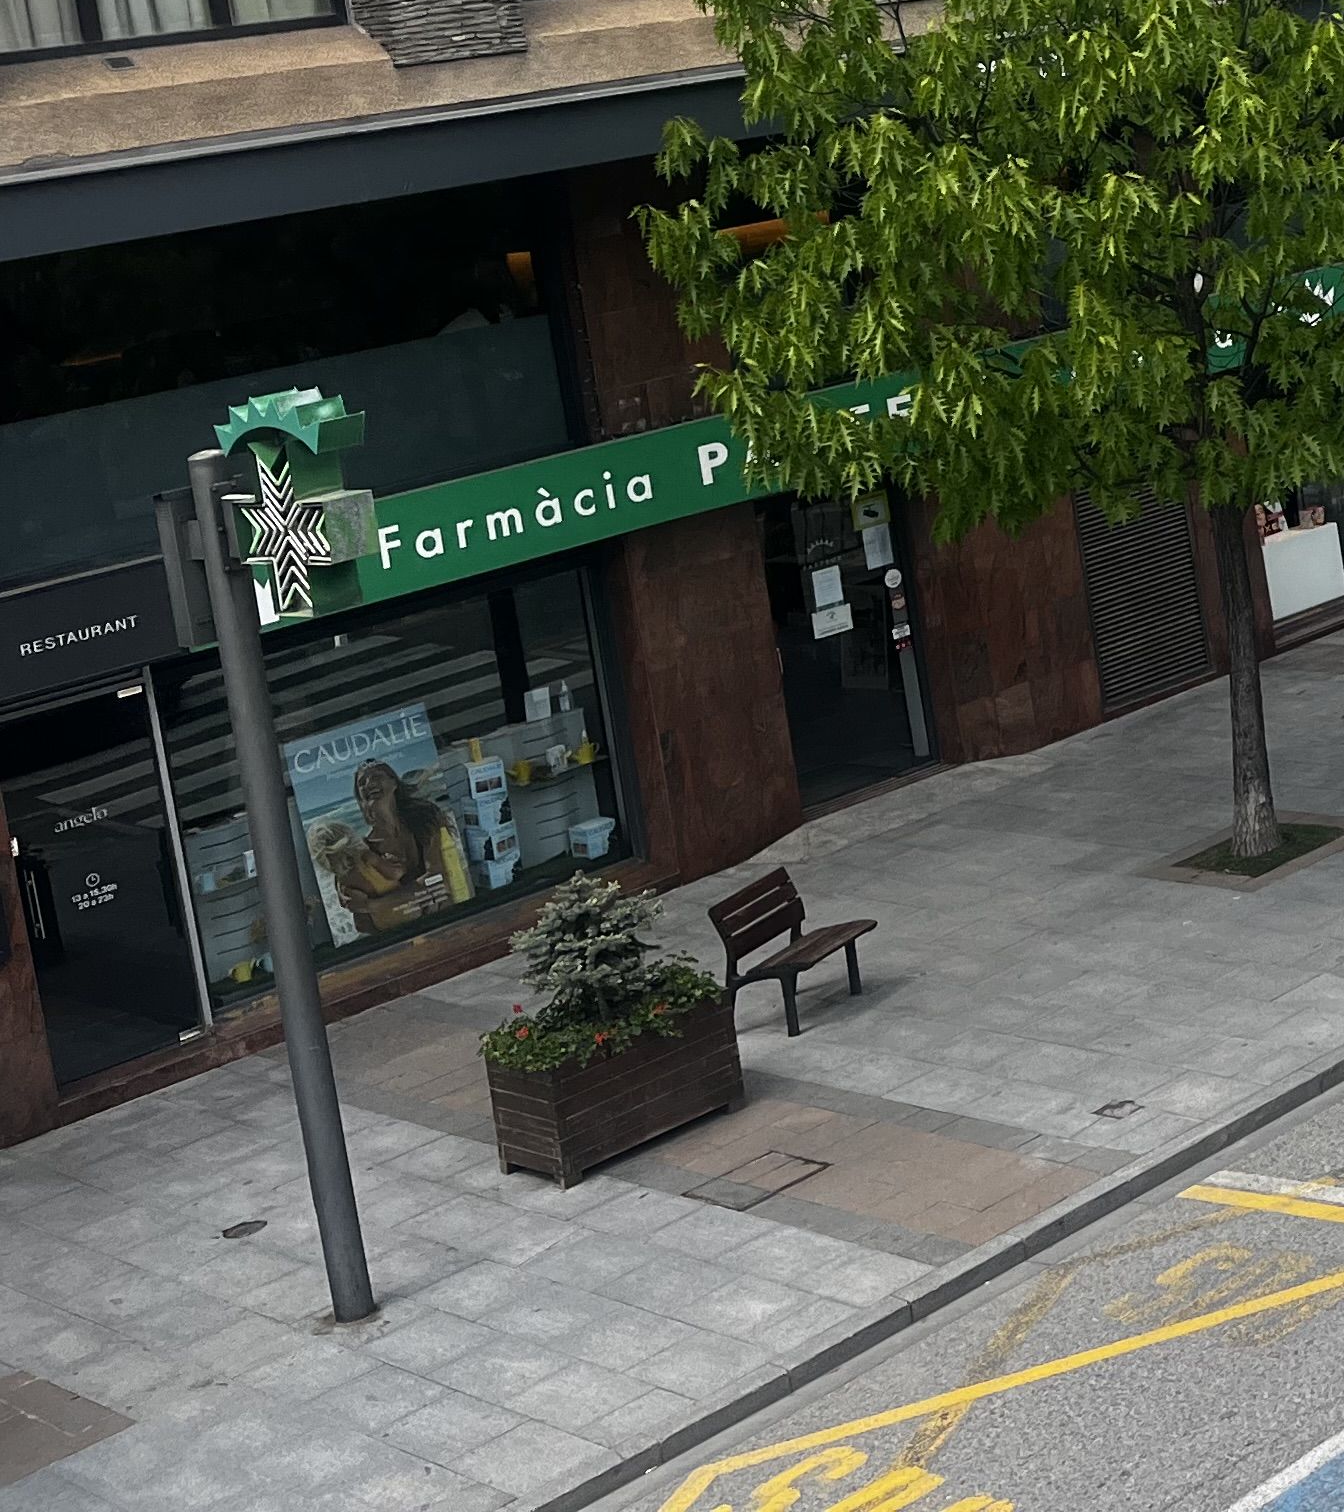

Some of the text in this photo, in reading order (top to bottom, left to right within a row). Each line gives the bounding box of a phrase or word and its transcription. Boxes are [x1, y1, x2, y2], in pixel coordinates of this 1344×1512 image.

[377, 471, 654, 569] Farmàcia
[19, 614, 138, 657] RESTAURANT
[54, 807, 108, 833] angelo
